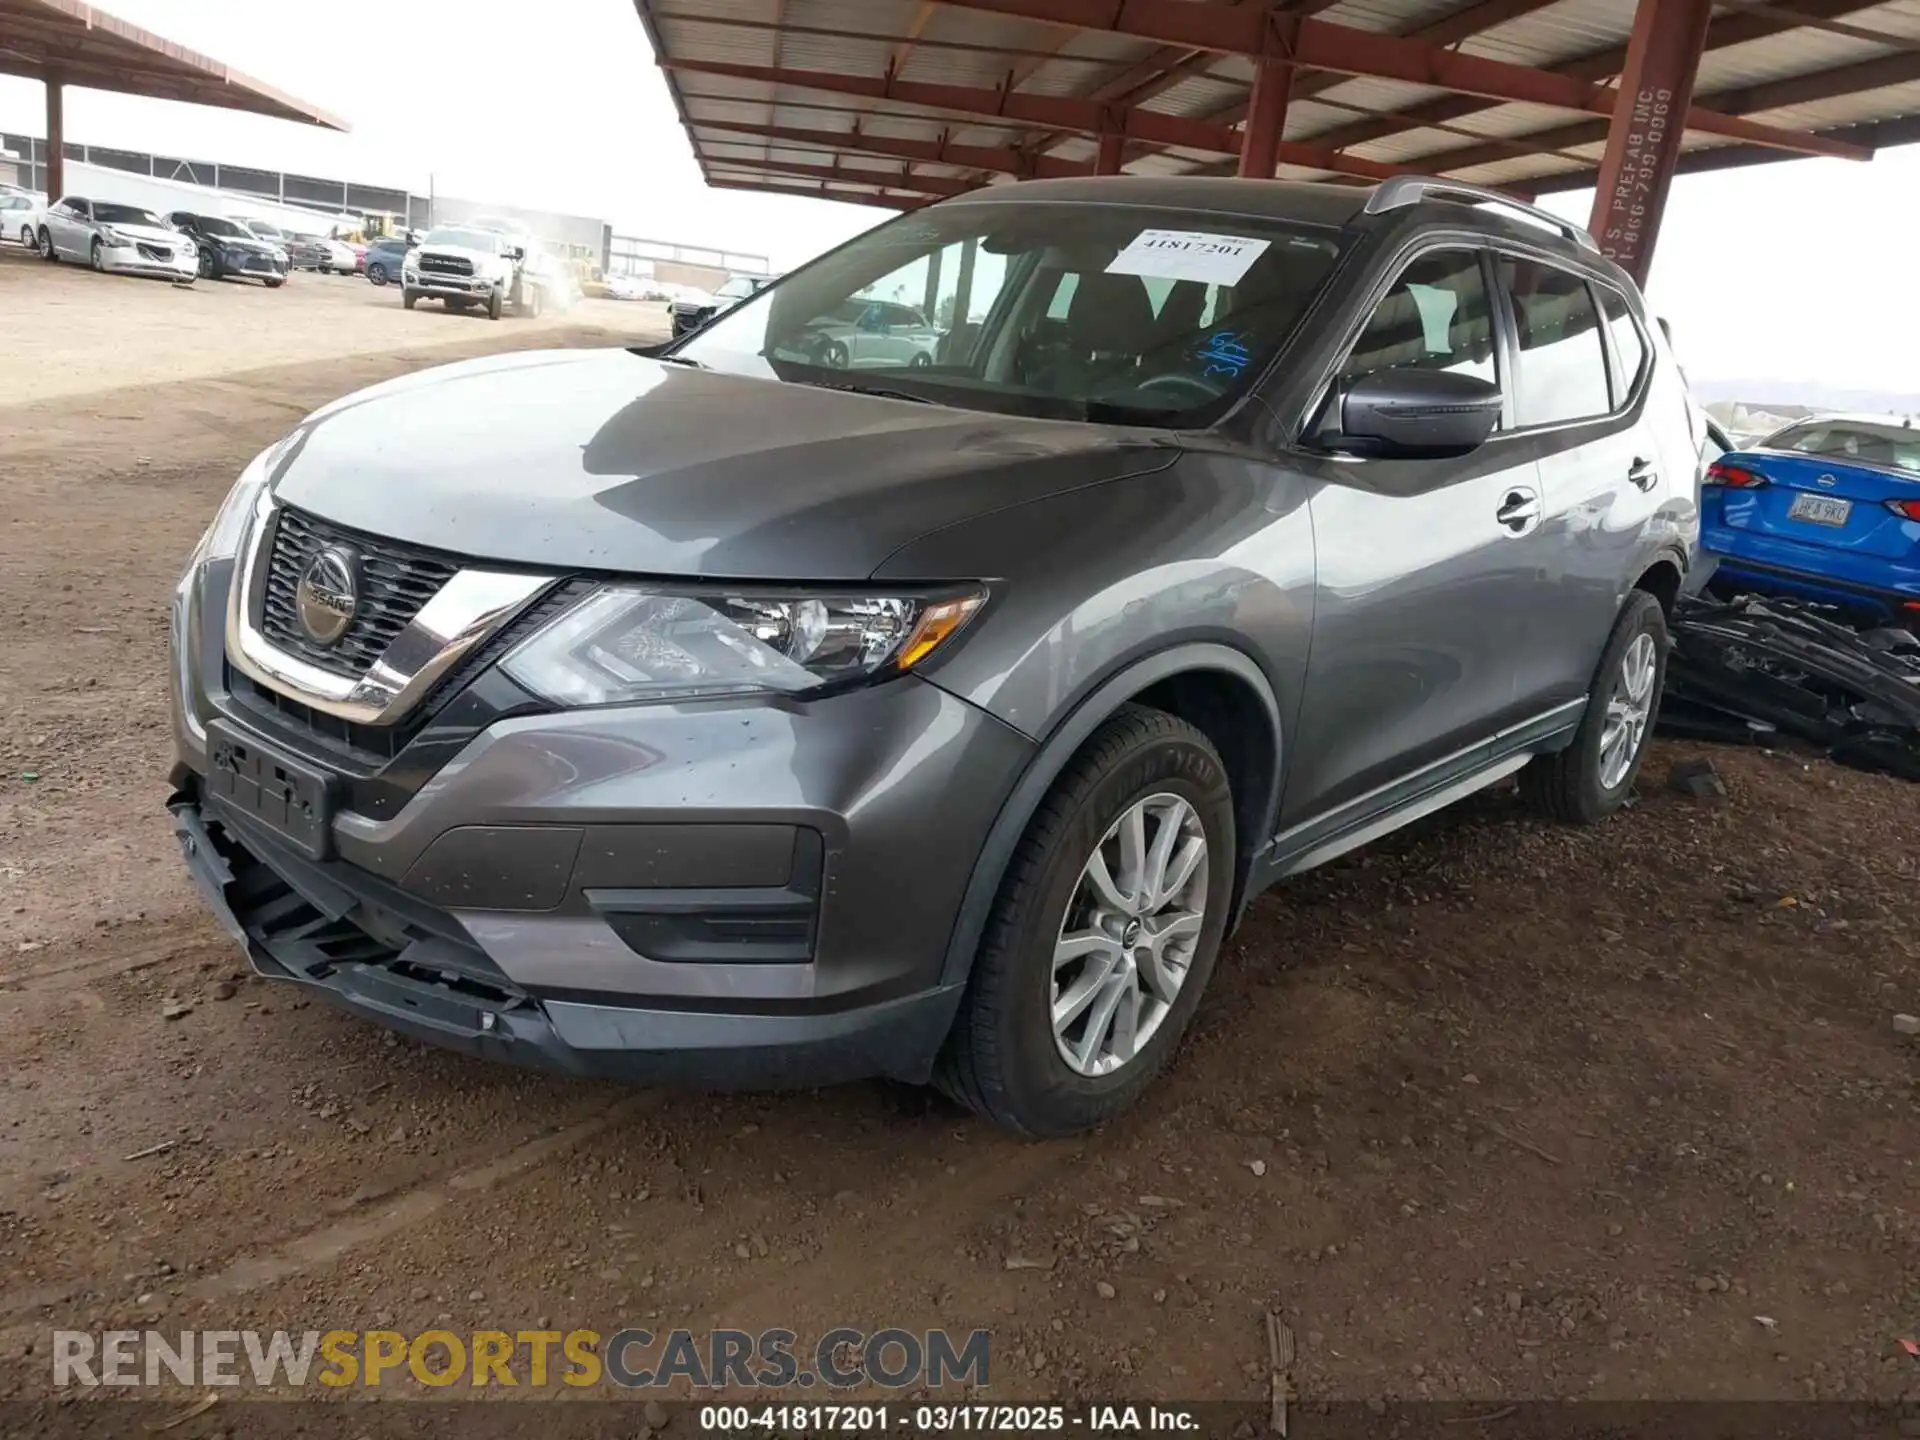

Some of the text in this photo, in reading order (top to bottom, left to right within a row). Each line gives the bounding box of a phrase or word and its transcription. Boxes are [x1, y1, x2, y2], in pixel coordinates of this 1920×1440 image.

[1613, 134, 1644, 211] PREFAB
[1620, 88, 1672, 260] 1-866-799-0969
[1144, 240, 1243, 256] 41817201
